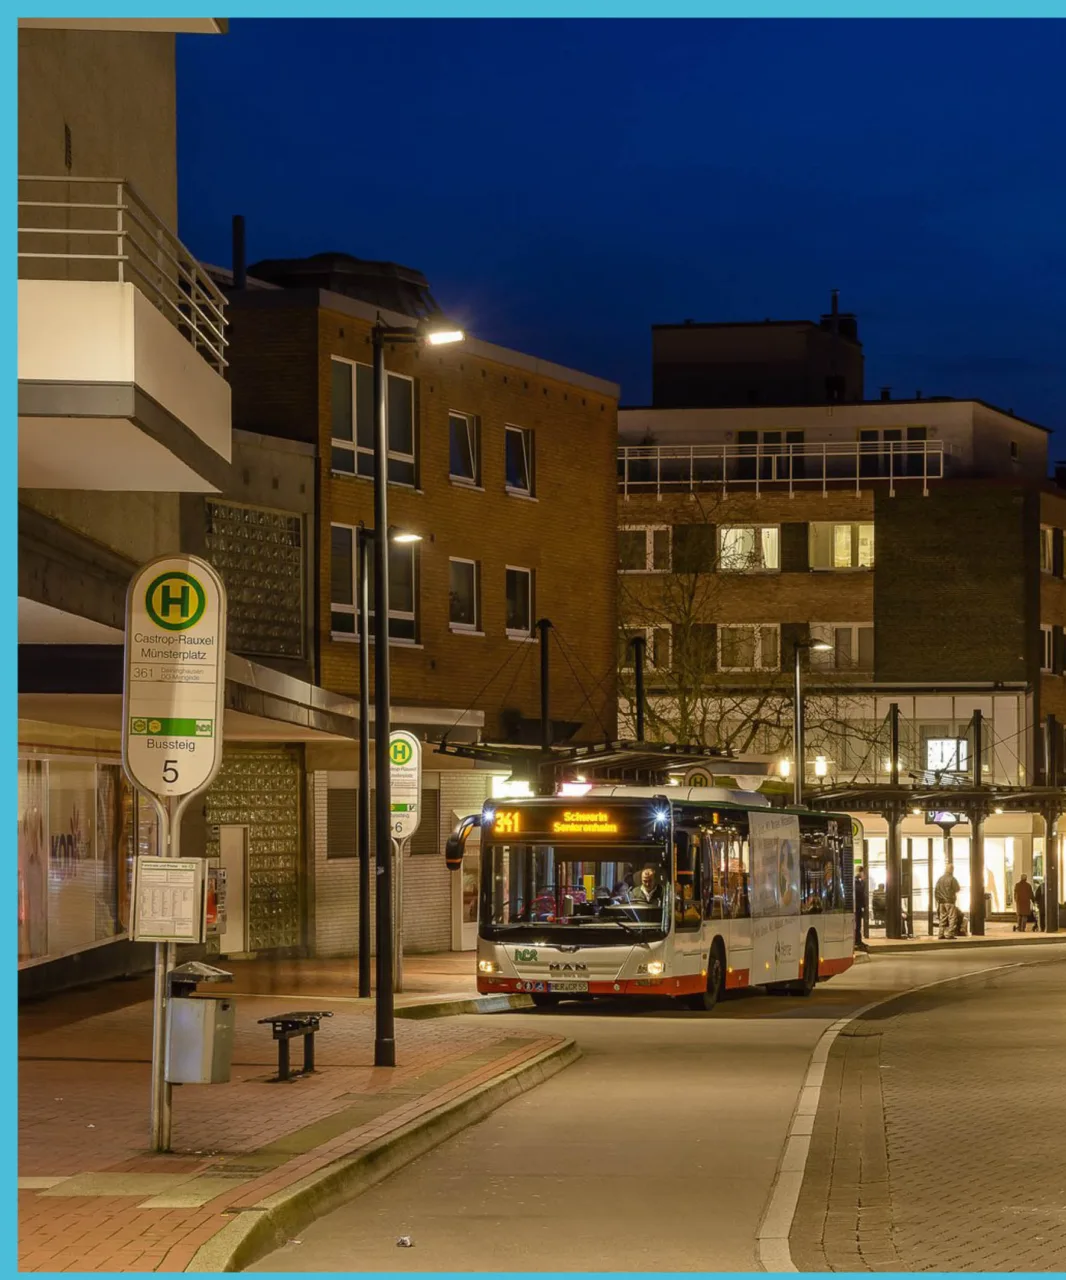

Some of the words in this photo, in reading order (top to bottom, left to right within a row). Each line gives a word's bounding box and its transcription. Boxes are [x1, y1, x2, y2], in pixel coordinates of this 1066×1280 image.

[161, 585, 190, 618] H
[134, 633, 214, 645] Castrop-Rauxel
[141, 648, 207, 661] Münsterplatz
[133, 667, 154, 679] 361
[146, 738, 196, 753] Bussteig
[393, 745, 406, 760] H
[162, 759, 179, 784] 5
[563, 811, 609, 823] Schwerin
[395, 821, 403, 833] 6
[549, 964, 587, 972] MAN
